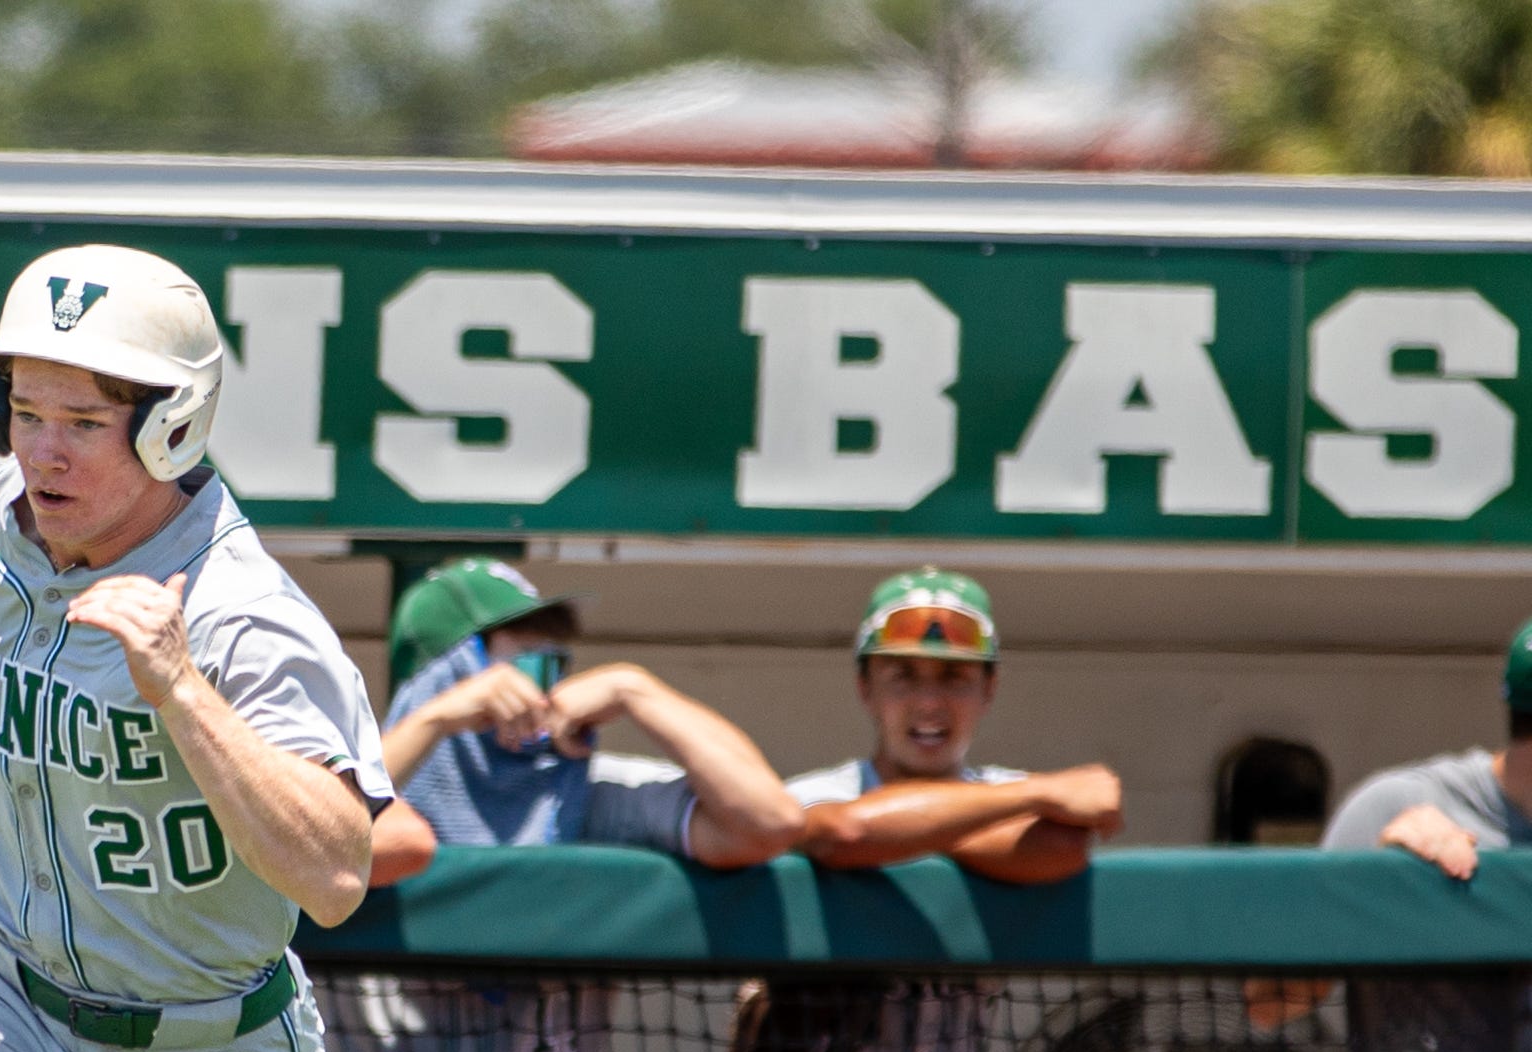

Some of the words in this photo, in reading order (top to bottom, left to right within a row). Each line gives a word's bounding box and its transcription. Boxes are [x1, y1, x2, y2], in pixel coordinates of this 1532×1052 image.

[47, 276, 109, 332] V
[735, 276, 1519, 519] BAS
[83, 799, 233, 893] 20
